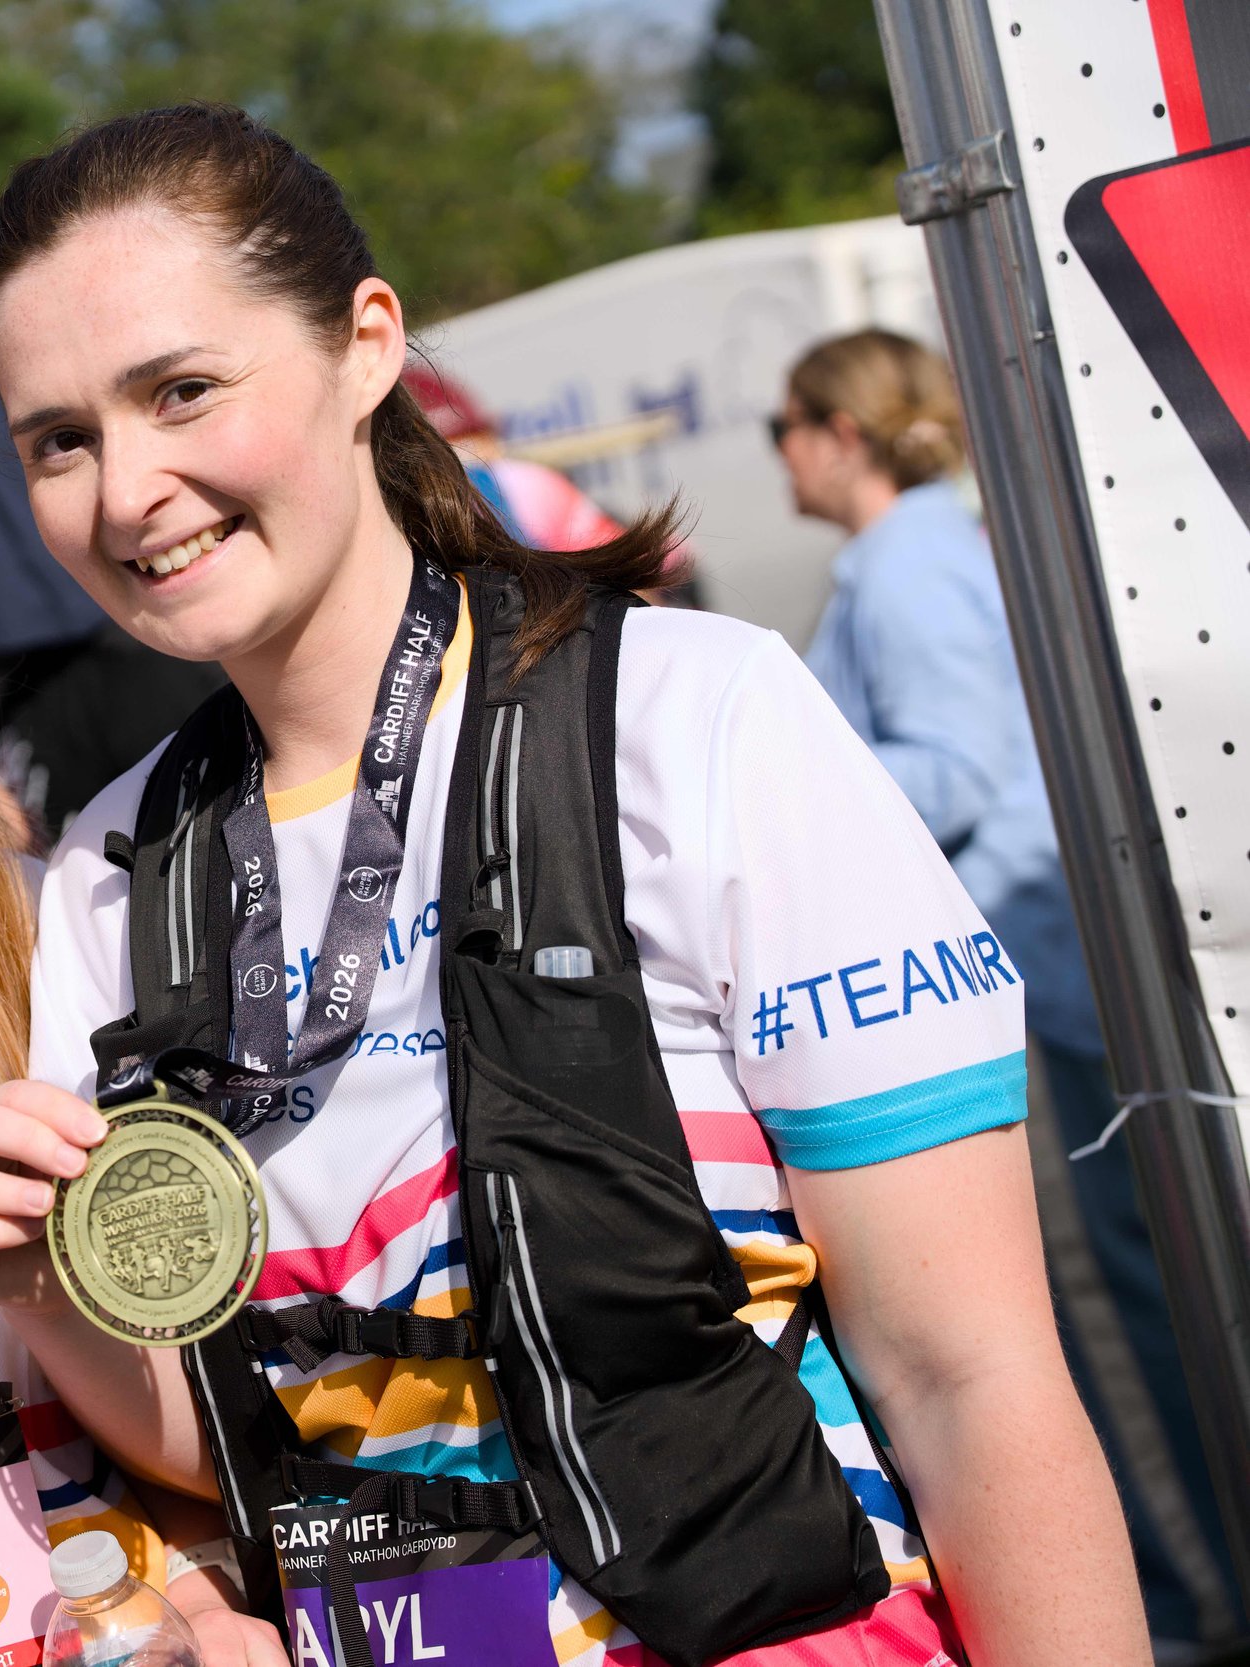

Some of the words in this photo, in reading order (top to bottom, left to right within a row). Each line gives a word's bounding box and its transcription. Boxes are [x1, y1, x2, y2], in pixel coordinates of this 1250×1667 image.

[374, 670, 413, 763] CARDIFF
[400, 610, 432, 666] HALF
[397, 722, 414, 767] HANNER
[407, 672, 431, 722] MARATHON
[244, 856, 263, 918] 2026
[325, 953, 361, 1022] 2026
[97, 1195, 160, 1225] CARDIFF
[164, 1187, 205, 1210] HALF
[103, 1207, 174, 1238] MARATHON
[177, 1203, 208, 1218] 2026
[279, 1555, 328, 1570] HANNER
[347, 1546, 400, 1565] ARATHON
[402, 1536, 457, 1557] CAERDYDD
[398, 1516, 440, 1536] HAL
[284, 1593, 445, 1667] AYL
